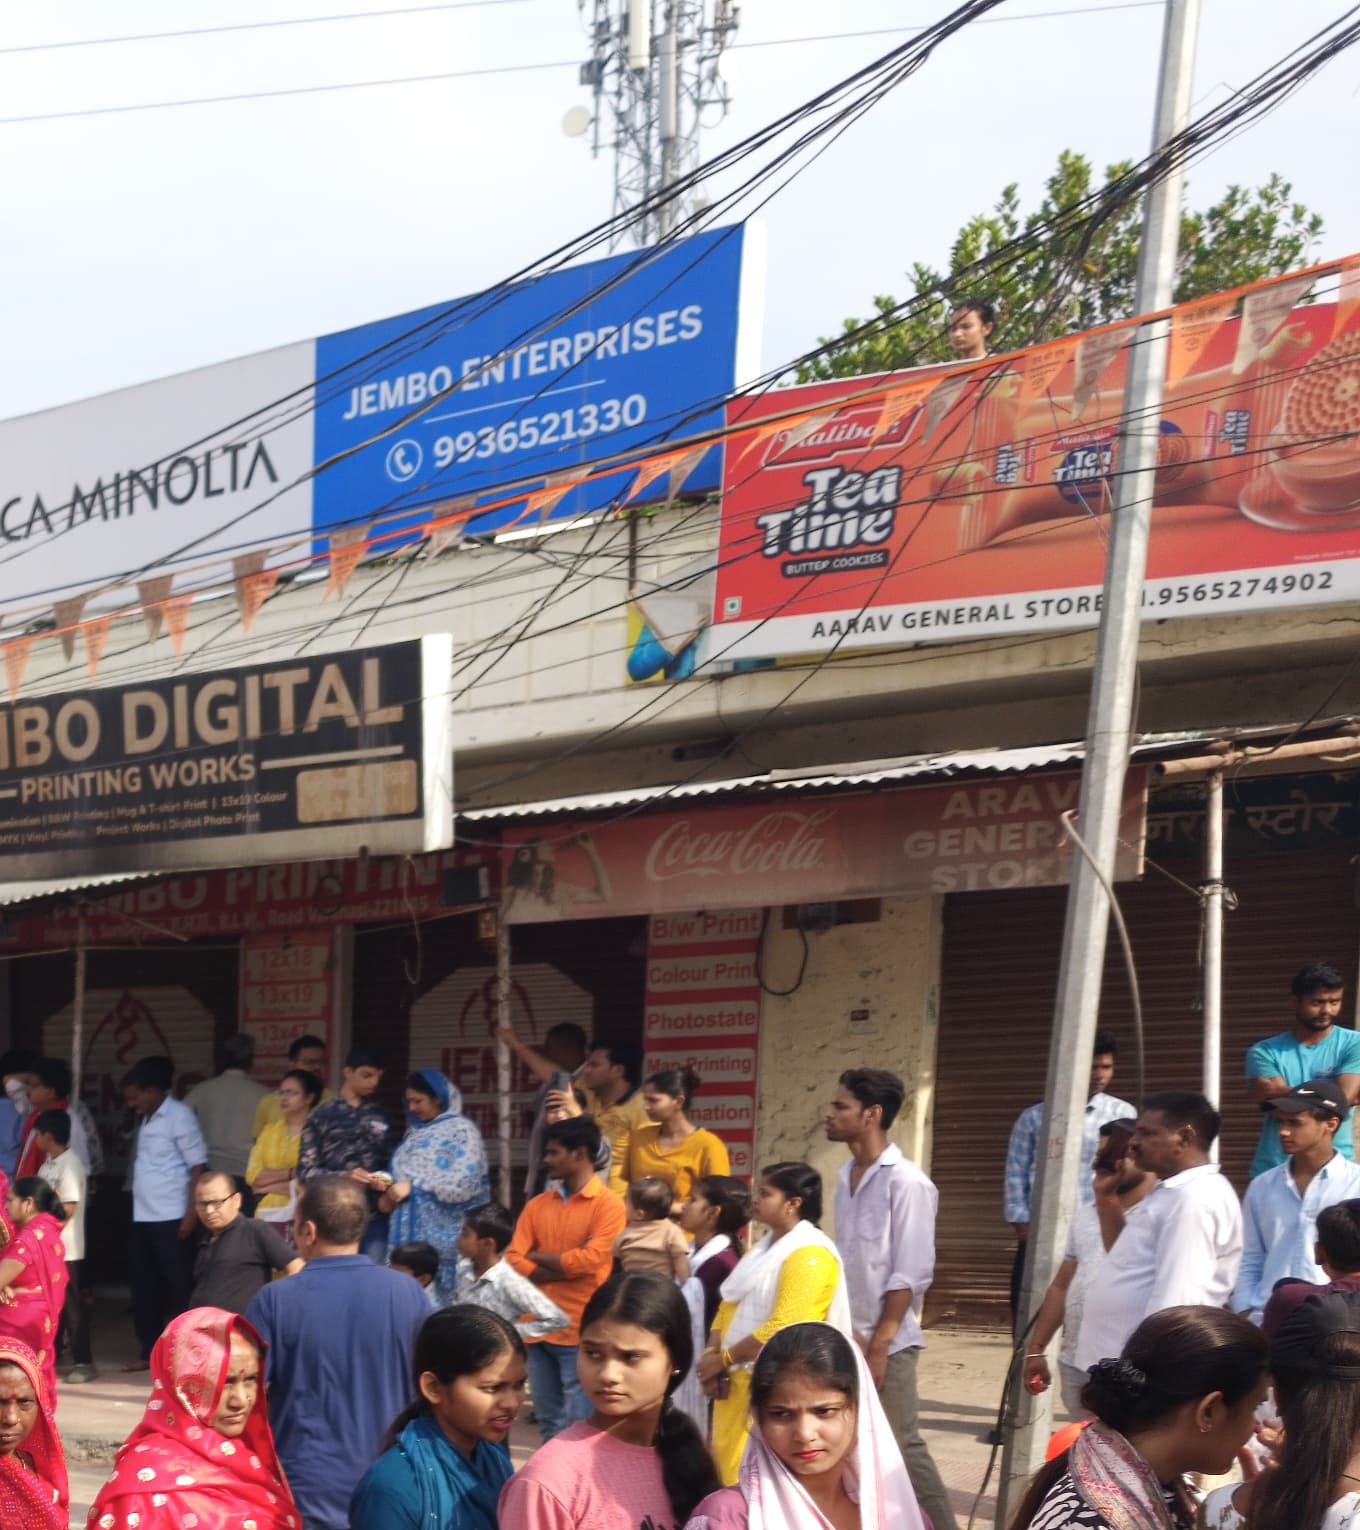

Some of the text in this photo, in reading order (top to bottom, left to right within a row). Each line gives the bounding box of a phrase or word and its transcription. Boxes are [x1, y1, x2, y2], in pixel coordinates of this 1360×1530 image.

[342, 304, 704, 420] JEMBO ENTERPRISES
[432, 393, 647, 468] 9936521330
[66, 438, 279, 524] MINOLTA
[1074, 450, 1113, 466] Tea
[804, 466, 903, 517] Tea
[756, 510, 894, 559] Time
[832, 552, 884, 571] COOKIES
[812, 613, 893, 639] AARAV
[902, 605, 1014, 631] GENERAL
[1024, 594, 1105, 619] STORE
[122, 657, 404, 755] DIGITAL
[20, 753, 256, 804] PRINTING WORKS
[254, 792, 287, 804] Colour
[167, 816, 201, 830] Digital
[203, 813, 232, 826] Photo
[234, 811, 260, 824] Print
[1245, 788, 1352, 838] स्टोर
[644, 808, 840, 882] Coca-Cola
[652, 912, 760, 938] B/w Print
[649, 963, 709, 985] Colour
[647, 1009, 756, 1031] Photostate
[685, 1054, 752, 1074] Printing
